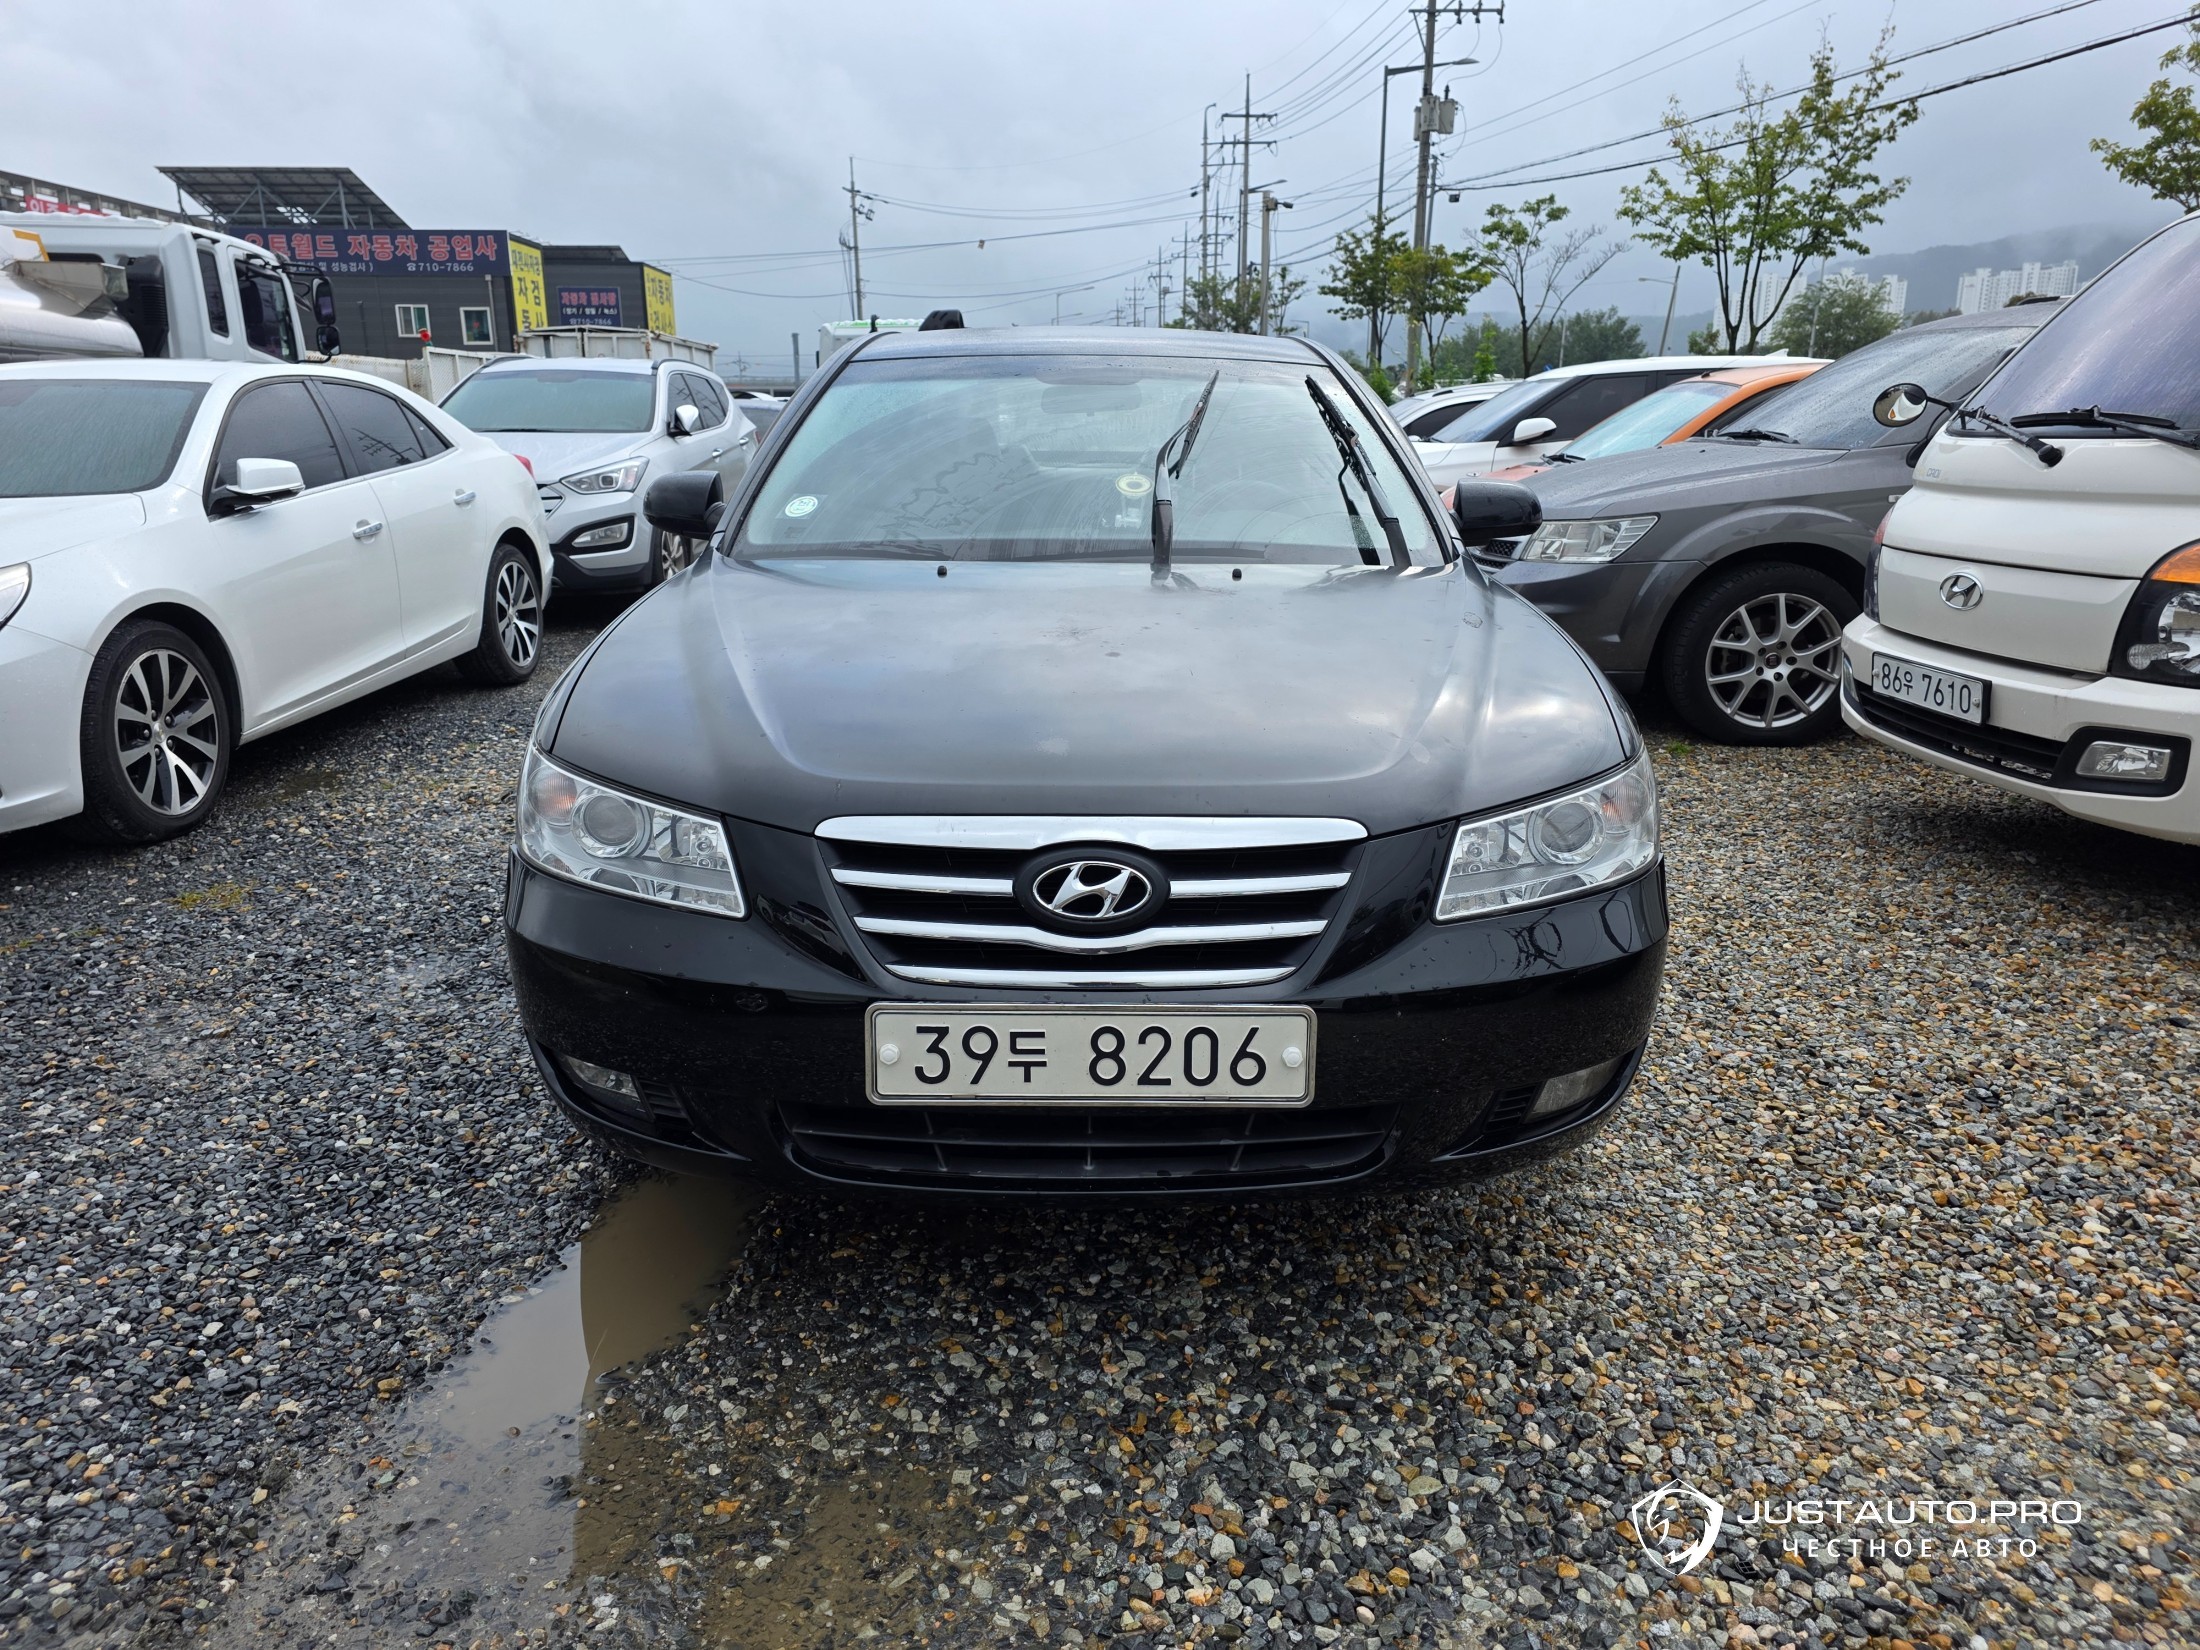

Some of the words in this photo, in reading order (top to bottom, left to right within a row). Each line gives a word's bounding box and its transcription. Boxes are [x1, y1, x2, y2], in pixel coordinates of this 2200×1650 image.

[347, 234, 418, 261] 자동차
[427, 235, 498, 261] 공업사
[418, 262, 474, 272] 710-7866
[1881, 662, 1914, 696] 86우
[1922, 673, 1972, 714] 7610
[914, 1025, 1048, 1085] 39두
[1088, 1025, 1268, 1087] 8206
